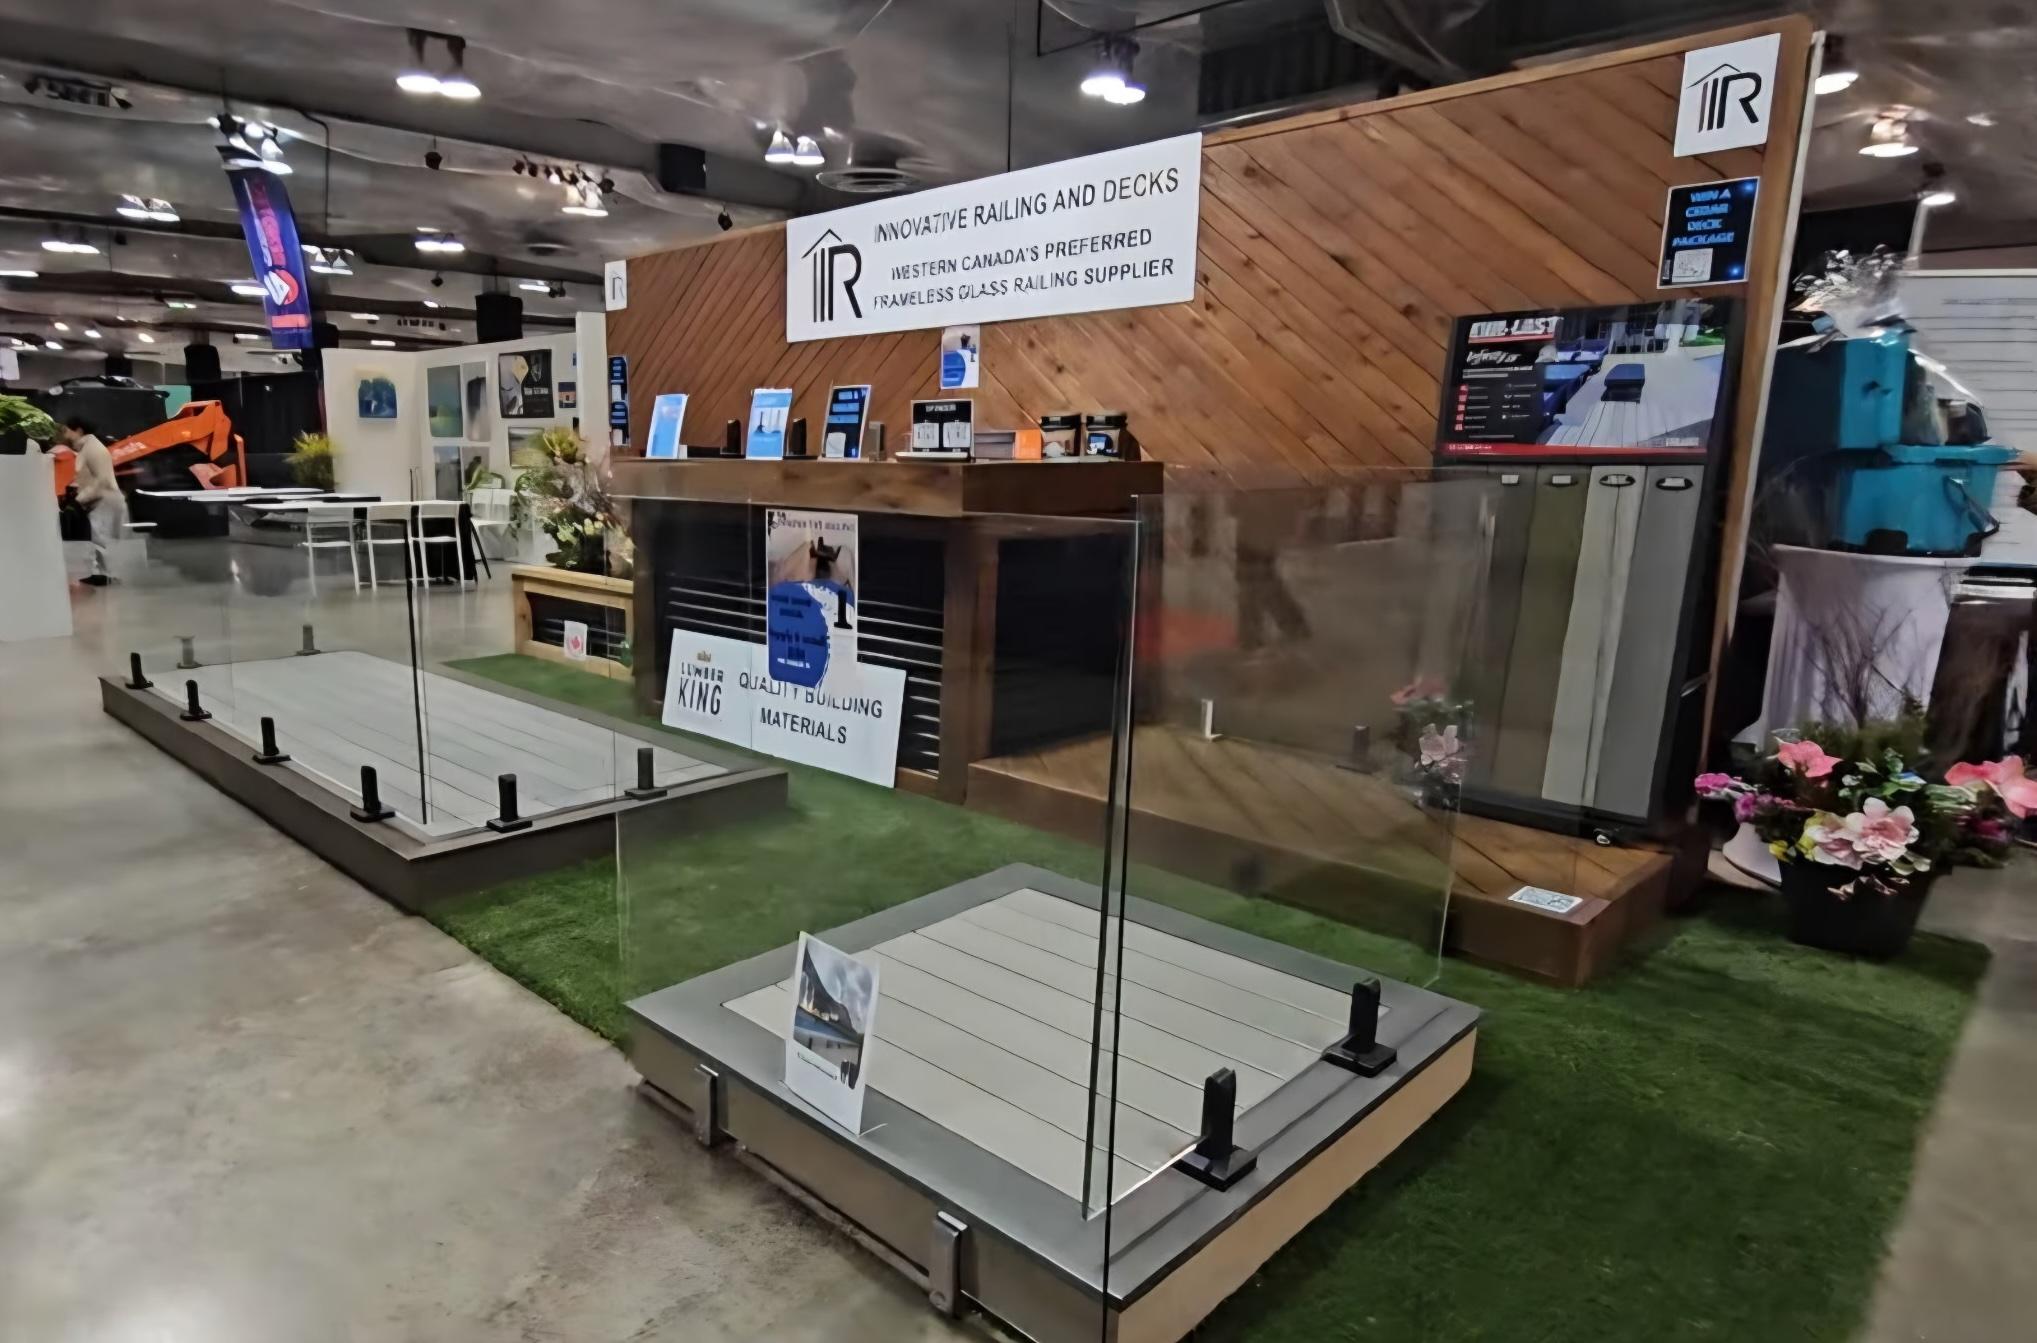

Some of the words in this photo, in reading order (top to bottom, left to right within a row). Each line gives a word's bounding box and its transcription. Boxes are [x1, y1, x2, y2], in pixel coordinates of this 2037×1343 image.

[874, 207, 968, 243] INNOVATIVE
[974, 192, 1047, 227] RAILING
[1053, 184, 1096, 213] AND
[1103, 167, 1179, 203] DECKS
[891, 258, 957, 281] WESTERN
[962, 245, 1040, 271] CANADA'S
[1045, 228, 1152, 259] PREFERRED
[873, 286, 954, 310] FRAMELESS
[958, 279, 1008, 300] GLASS
[1014, 270, 1078, 296] RAILING
[1084, 258, 1174, 285] SUPPLIER
[678, 676, 722, 716] KING
[760, 706, 847, 744] MATERIALS
